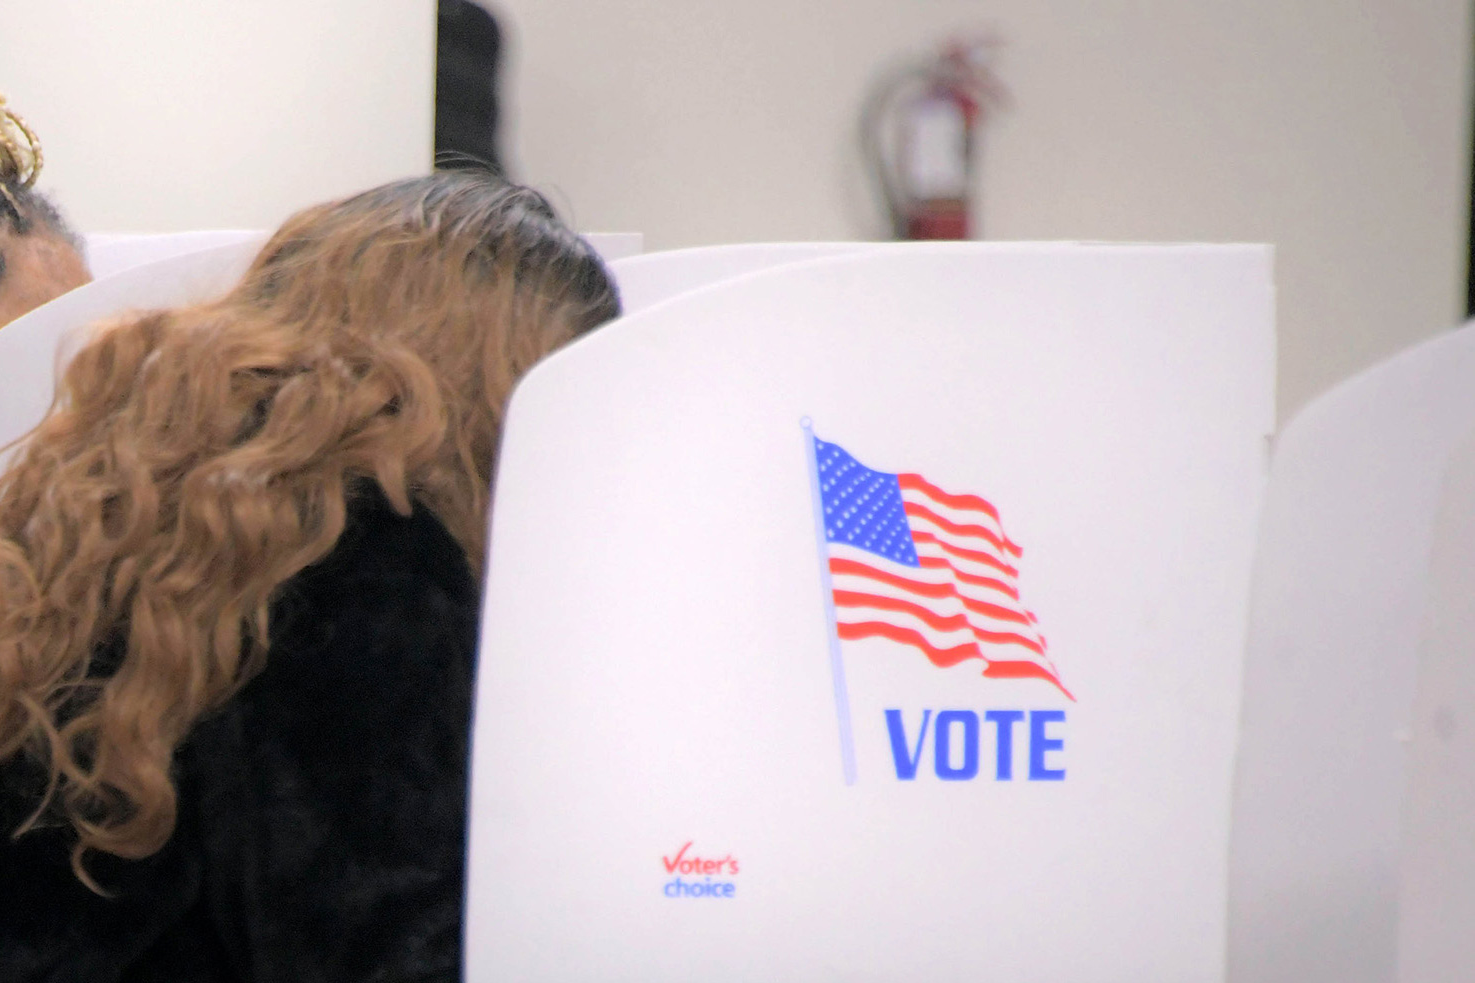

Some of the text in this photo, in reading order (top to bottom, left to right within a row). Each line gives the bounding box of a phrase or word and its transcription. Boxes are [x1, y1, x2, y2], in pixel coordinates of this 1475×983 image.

[883, 708, 1067, 782] VOTE
[662, 841, 739, 875] Voter's
[663, 877, 736, 899] choice
